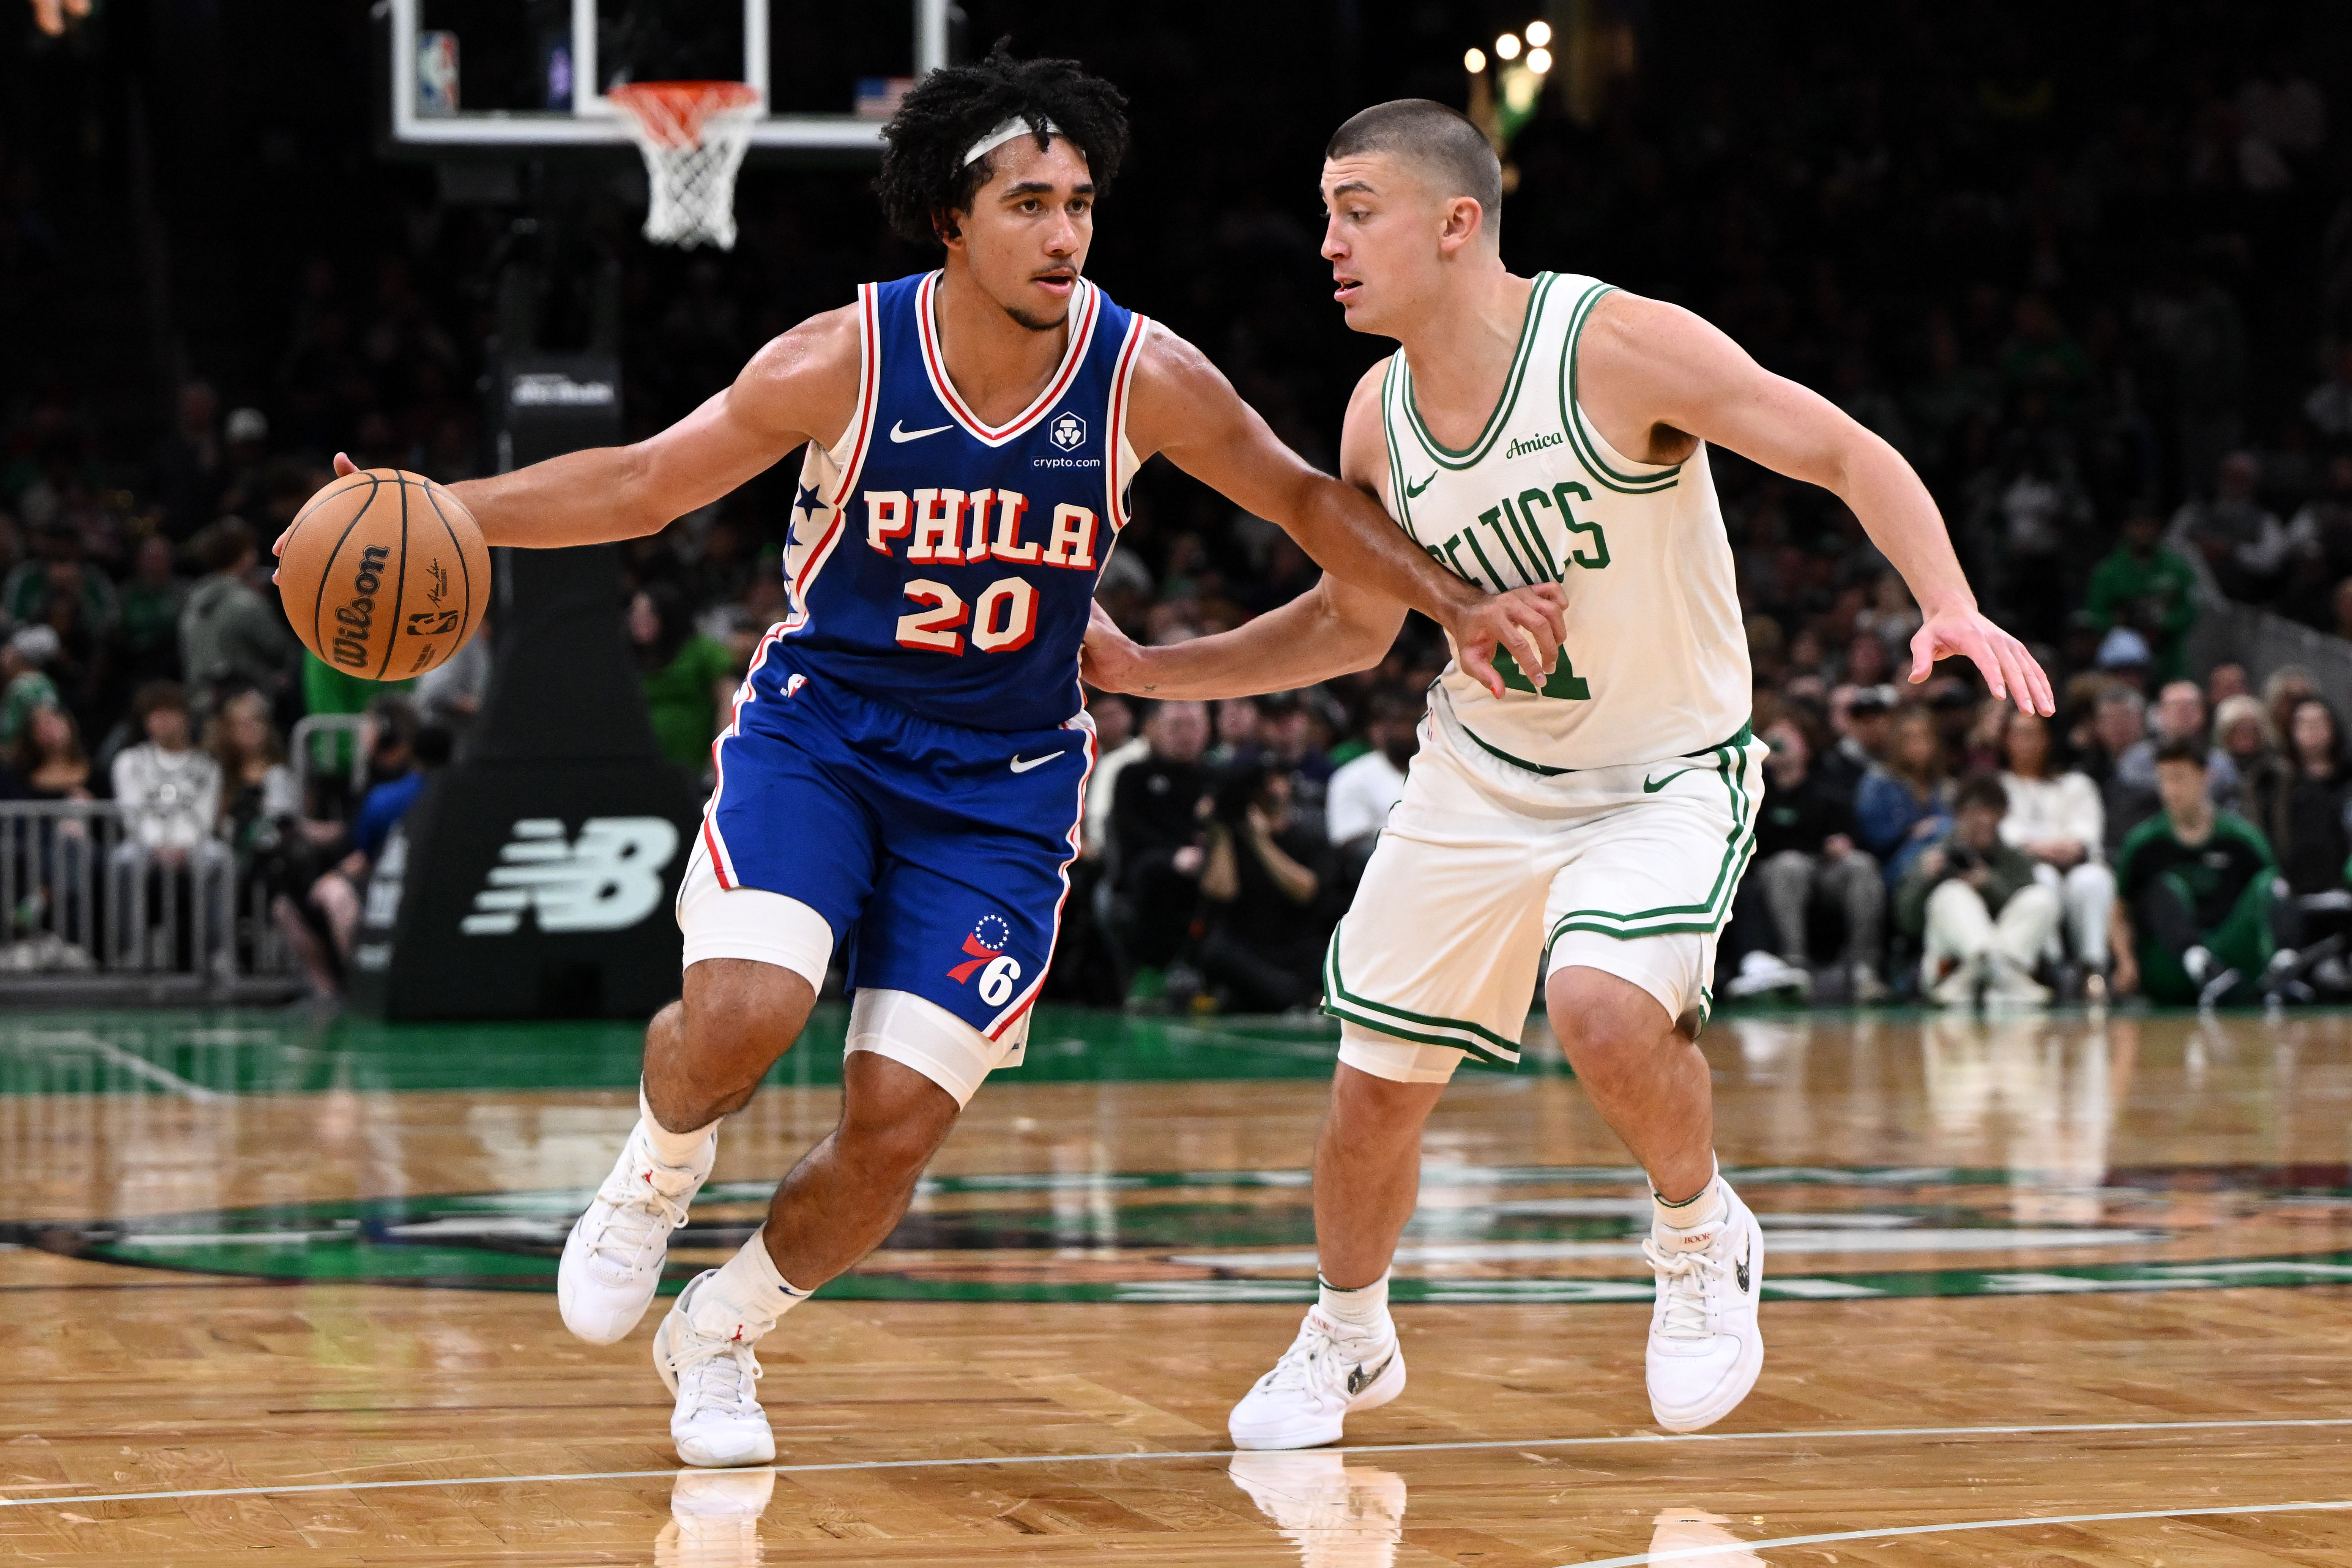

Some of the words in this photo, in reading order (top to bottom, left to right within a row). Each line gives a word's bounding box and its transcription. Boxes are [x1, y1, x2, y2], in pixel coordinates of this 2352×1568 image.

[1033, 457, 1100, 469] crypto.com
[1506, 431, 1564, 460] Amica
[863, 488, 1100, 570] PHILA
[333, 545, 390, 668] Wilson
[895, 576, 1040, 657] 20
[946, 932, 1022, 1007] 76
